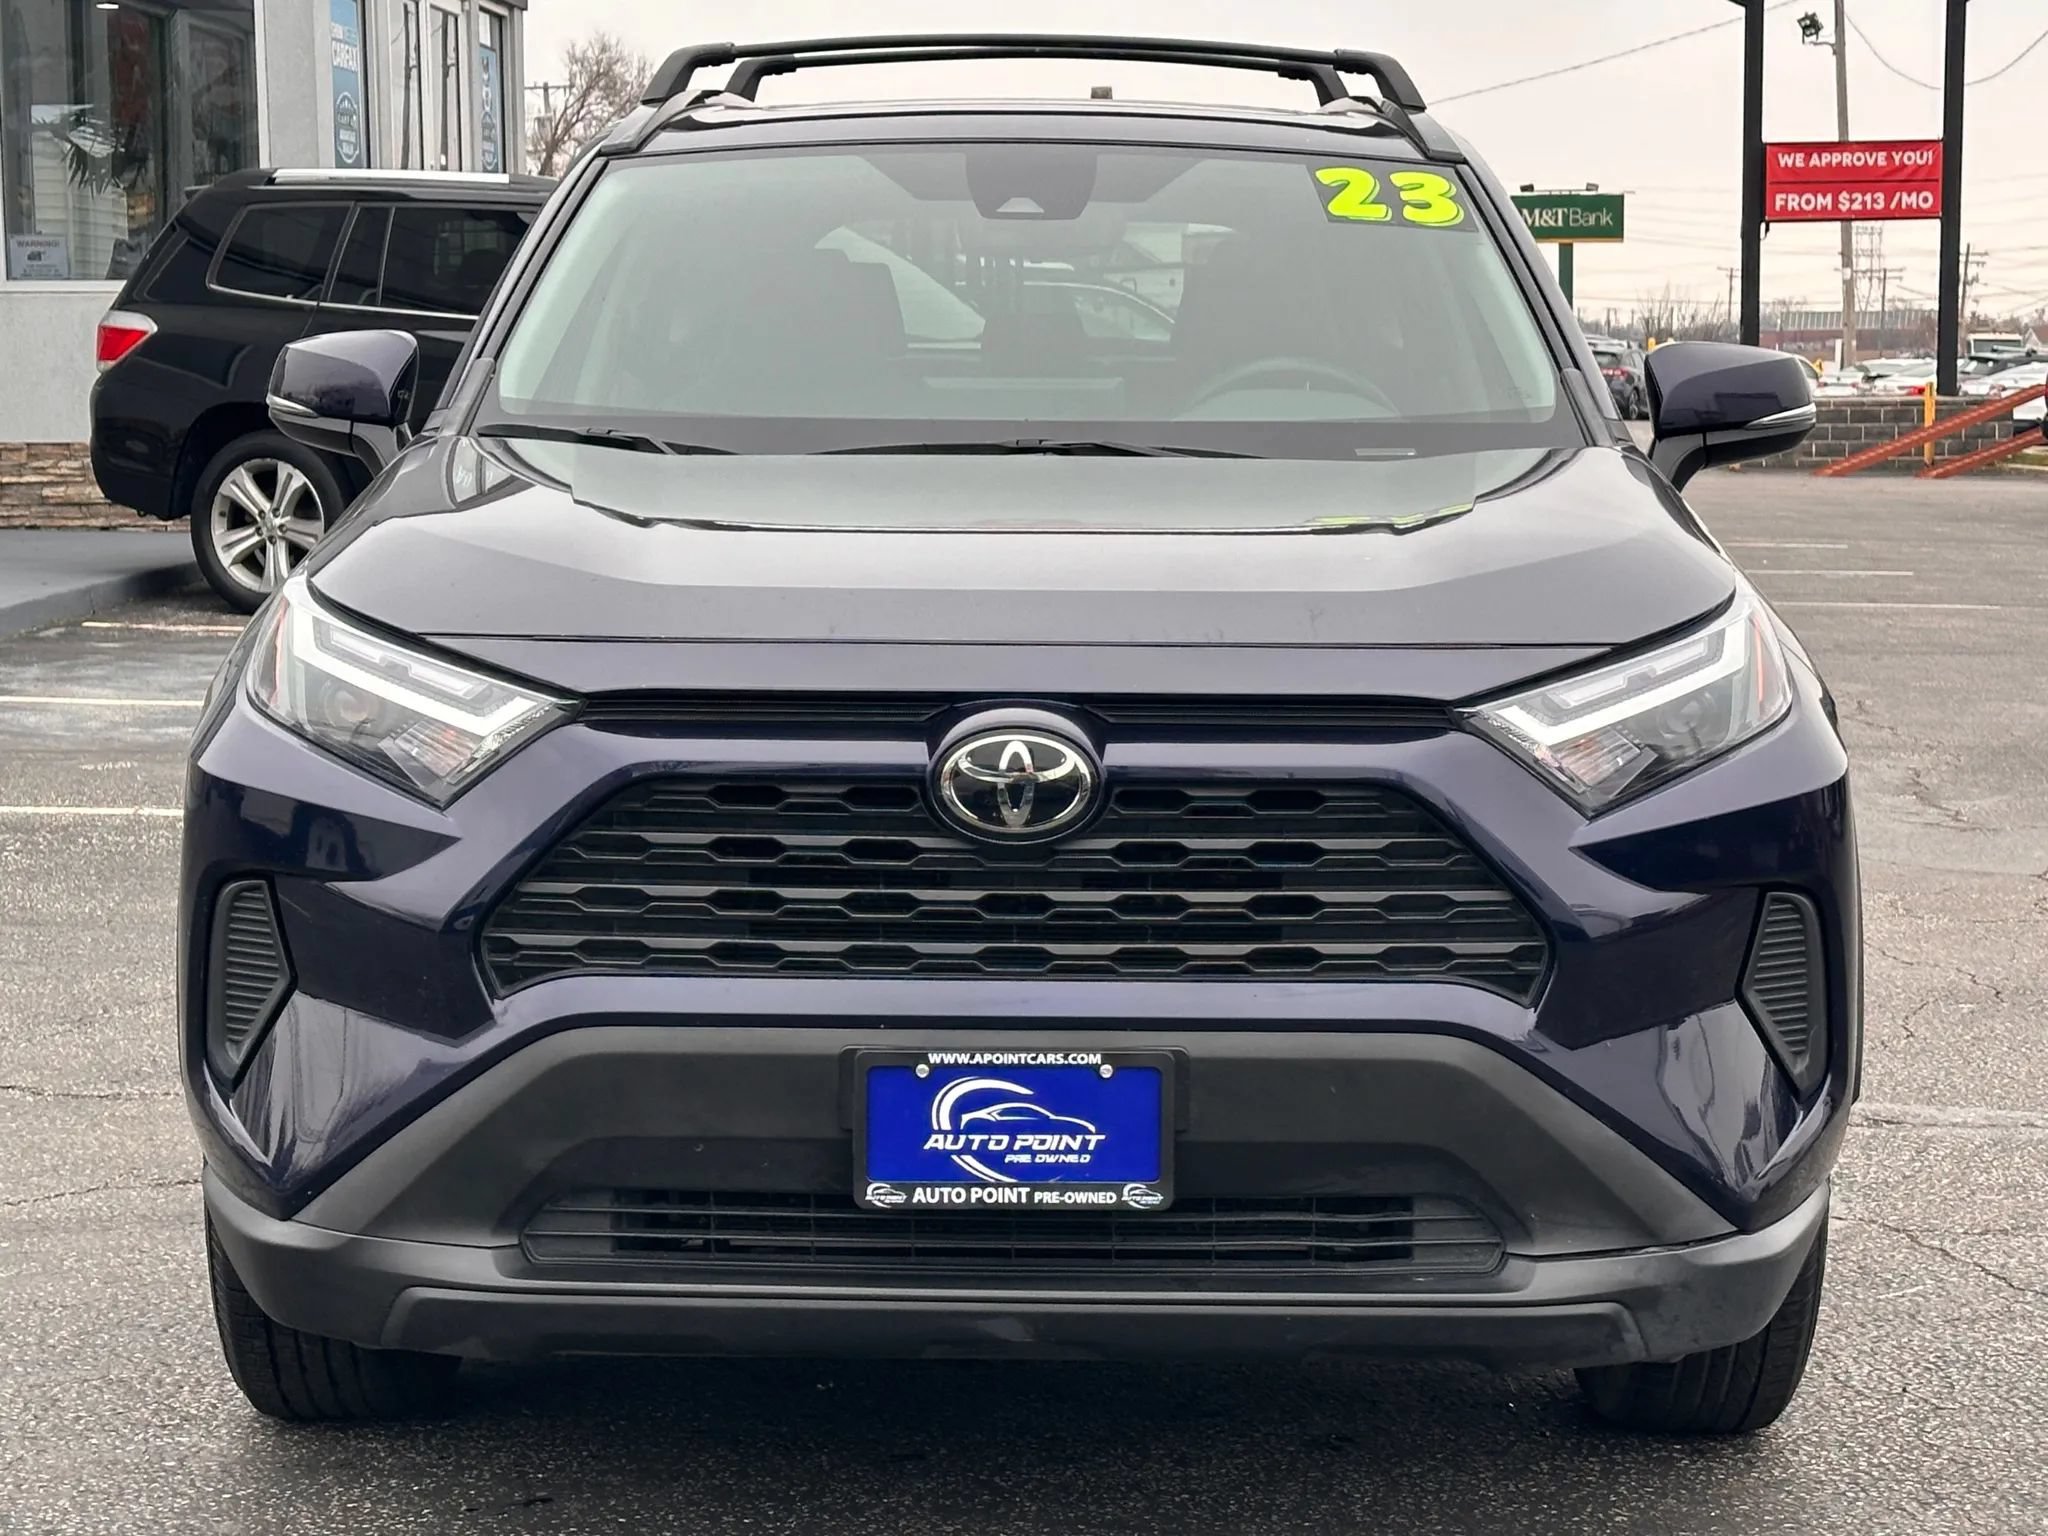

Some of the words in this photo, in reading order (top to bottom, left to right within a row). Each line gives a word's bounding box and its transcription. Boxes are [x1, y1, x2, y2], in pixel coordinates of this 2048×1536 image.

[1777, 152, 1805, 168] WE
[1808, 151, 1888, 168] APPROVE
[1315, 166, 1465, 228] 23
[1774, 192, 1833, 212] FROM
[1837, 190, 1886, 212] $213
[1889, 190, 1934, 210] /MO
[1521, 207, 1569, 228] M&T
[1569, 207, 1613, 227] Bank
[928, 1053, 1102, 1066] WWW.APOINTCARS.COM
[923, 1134, 1010, 1151] AUTO
[1013, 1134, 1106, 1151] POINT
[1004, 1154, 1032, 1164] PRE
[1034, 1154, 1091, 1164] OWNED
[912, 1187, 966, 1204] AUTO
[970, 1187, 1030, 1204] POINT
[1034, 1191, 1117, 1204] PRE-OWNED
